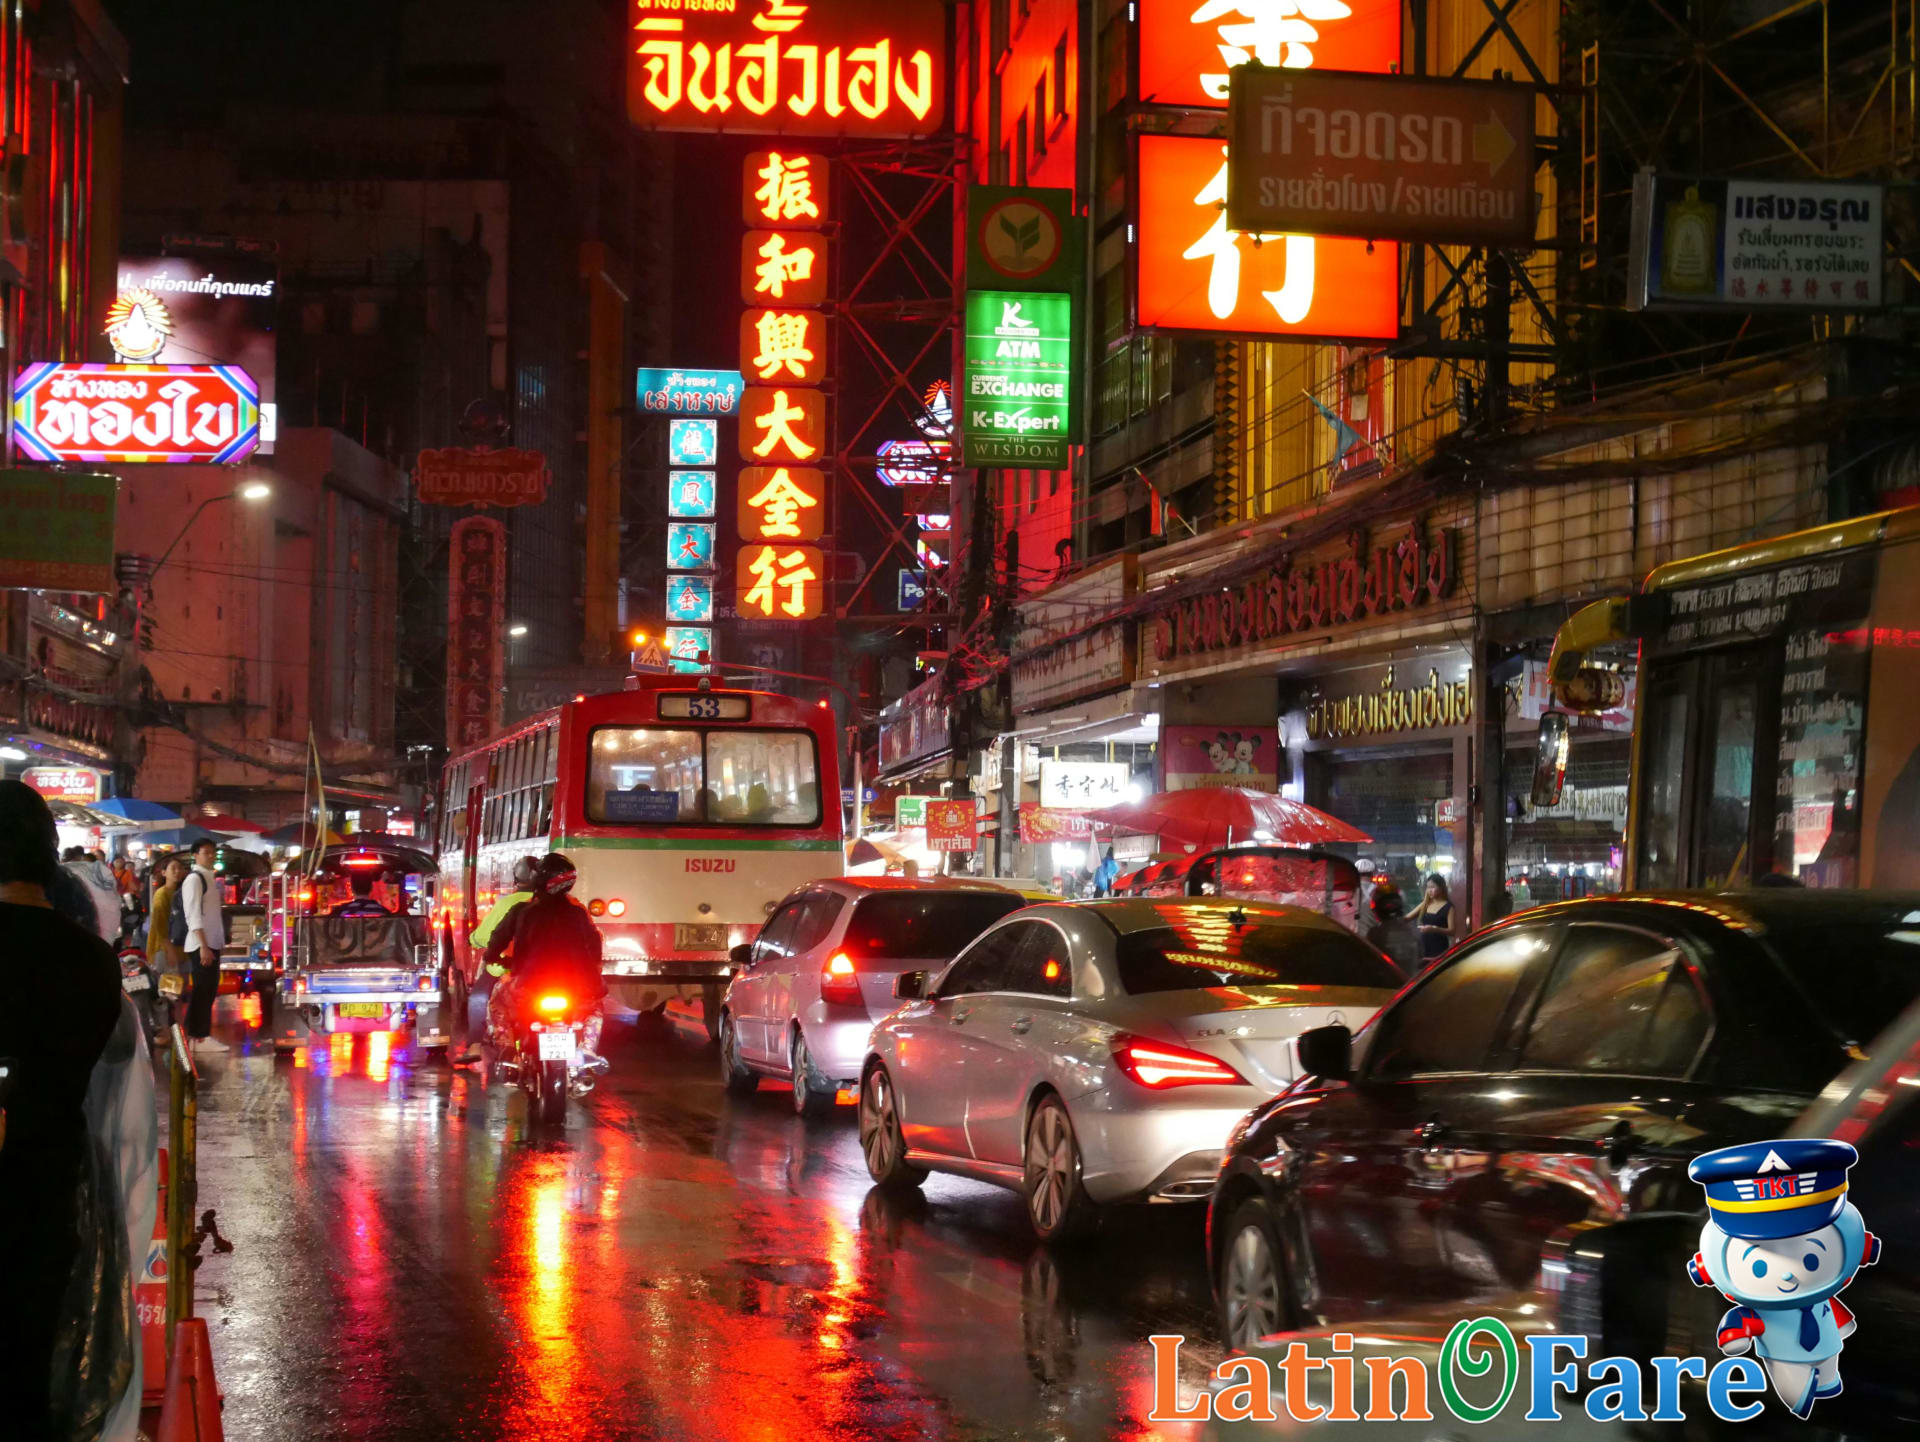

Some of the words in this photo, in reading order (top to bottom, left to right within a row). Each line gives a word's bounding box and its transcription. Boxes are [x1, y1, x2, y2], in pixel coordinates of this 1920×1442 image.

[1260, 82, 1464, 166] ที่จอดรถ
[1734, 193, 1870, 231] แสงอรุณ
[1001, 301, 1034, 328] K
[996, 341, 1041, 359] ATM
[50, 371, 147, 399] ห้างทอง
[743, 151, 820, 618] 振和興大金行
[971, 375, 1008, 383] CURRENCY
[644, 384, 736, 412] เล่งหงษ์
[971, 382, 1064, 398] EXCHANGE
[974, 443, 1059, 457] WISDOM
[687, 697, 721, 718] 53
[930, 833, 972, 850] เกาลัด
[684, 858, 736, 873] ISUZU
[548, 1050, 567, 1059] 721
